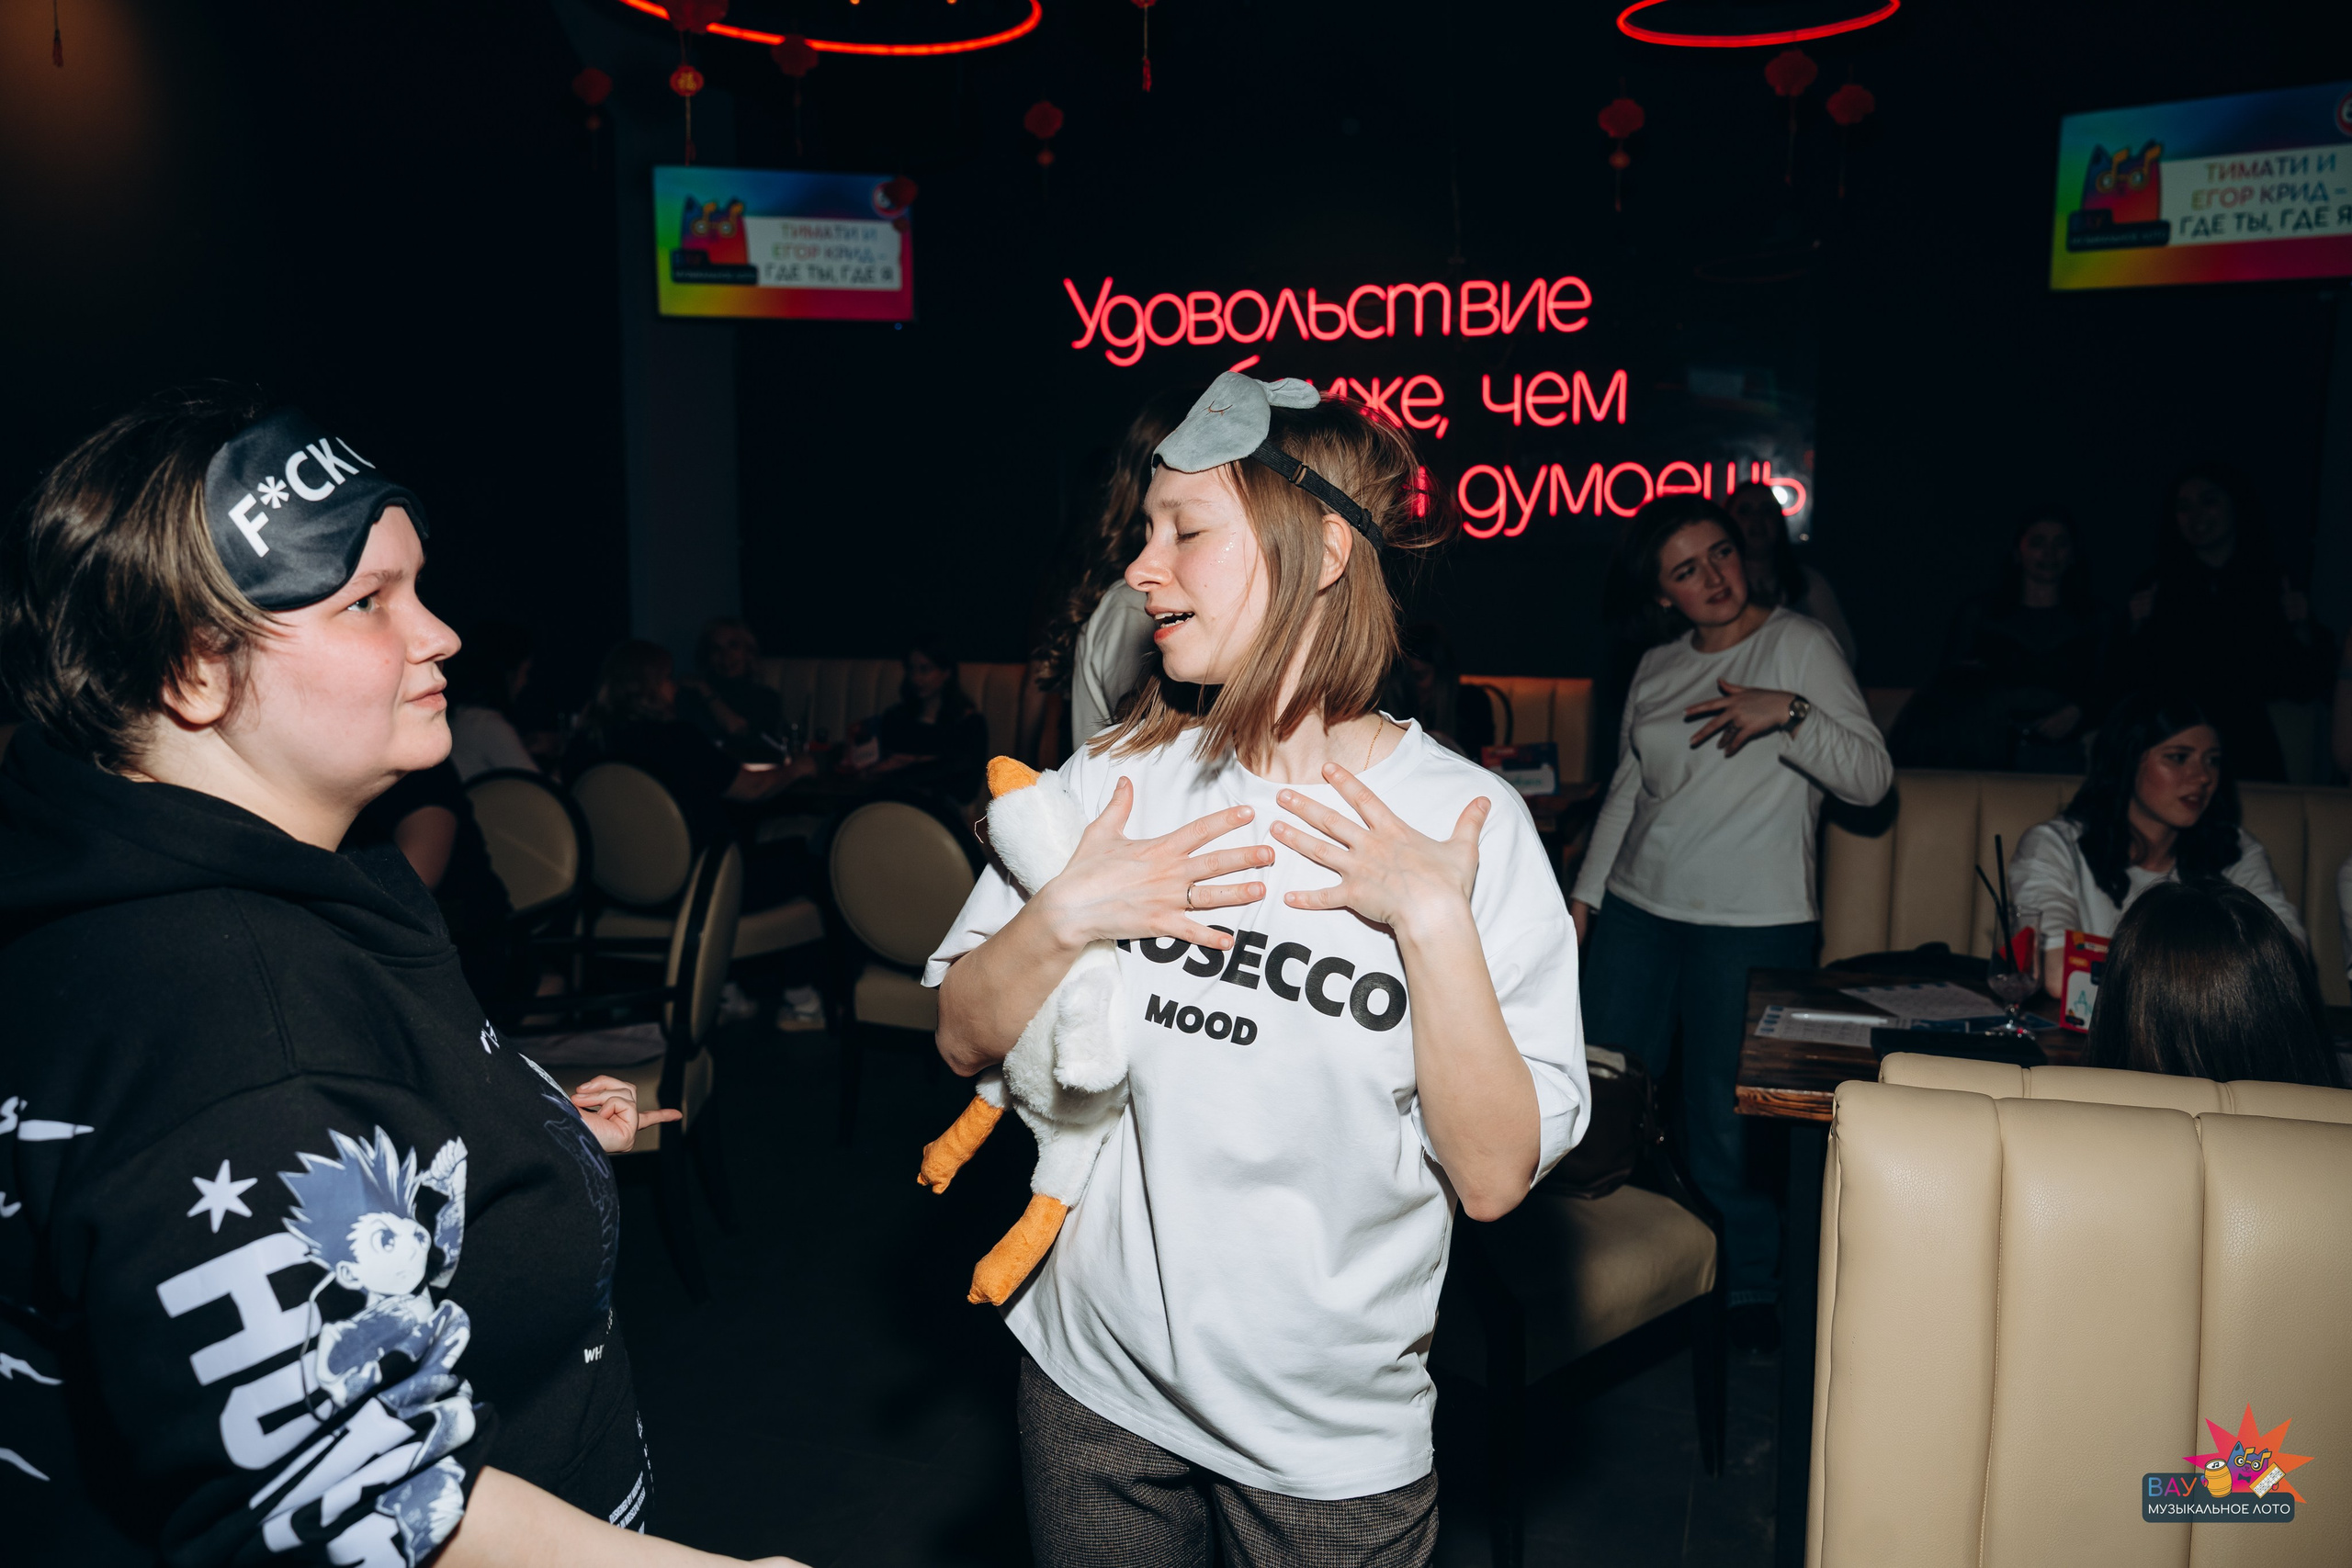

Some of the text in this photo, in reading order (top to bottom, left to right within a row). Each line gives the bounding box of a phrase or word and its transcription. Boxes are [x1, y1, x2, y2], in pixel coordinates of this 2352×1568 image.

[2205, 152, 2337, 183] ТИМАТИ И
[2191, 186, 2255, 211] ЕГОР
[2260, 180, 2331, 206] КРИД
[781, 222, 859, 240] ТИМАТИ
[2179, 212, 2226, 240] ГДЕ
[2233, 209, 2273, 234] ТЫ,
[2279, 206, 2330, 232] ГДЕ
[772, 243, 820, 260] ЕГОР
[764, 262, 799, 281] ГДЕ
[841, 264, 876, 283] ГДЕ
[1063, 276, 1592, 367] Удовольствие
[1482, 369, 1628, 427] чем
[1144, 993, 1258, 1045] MOOD
